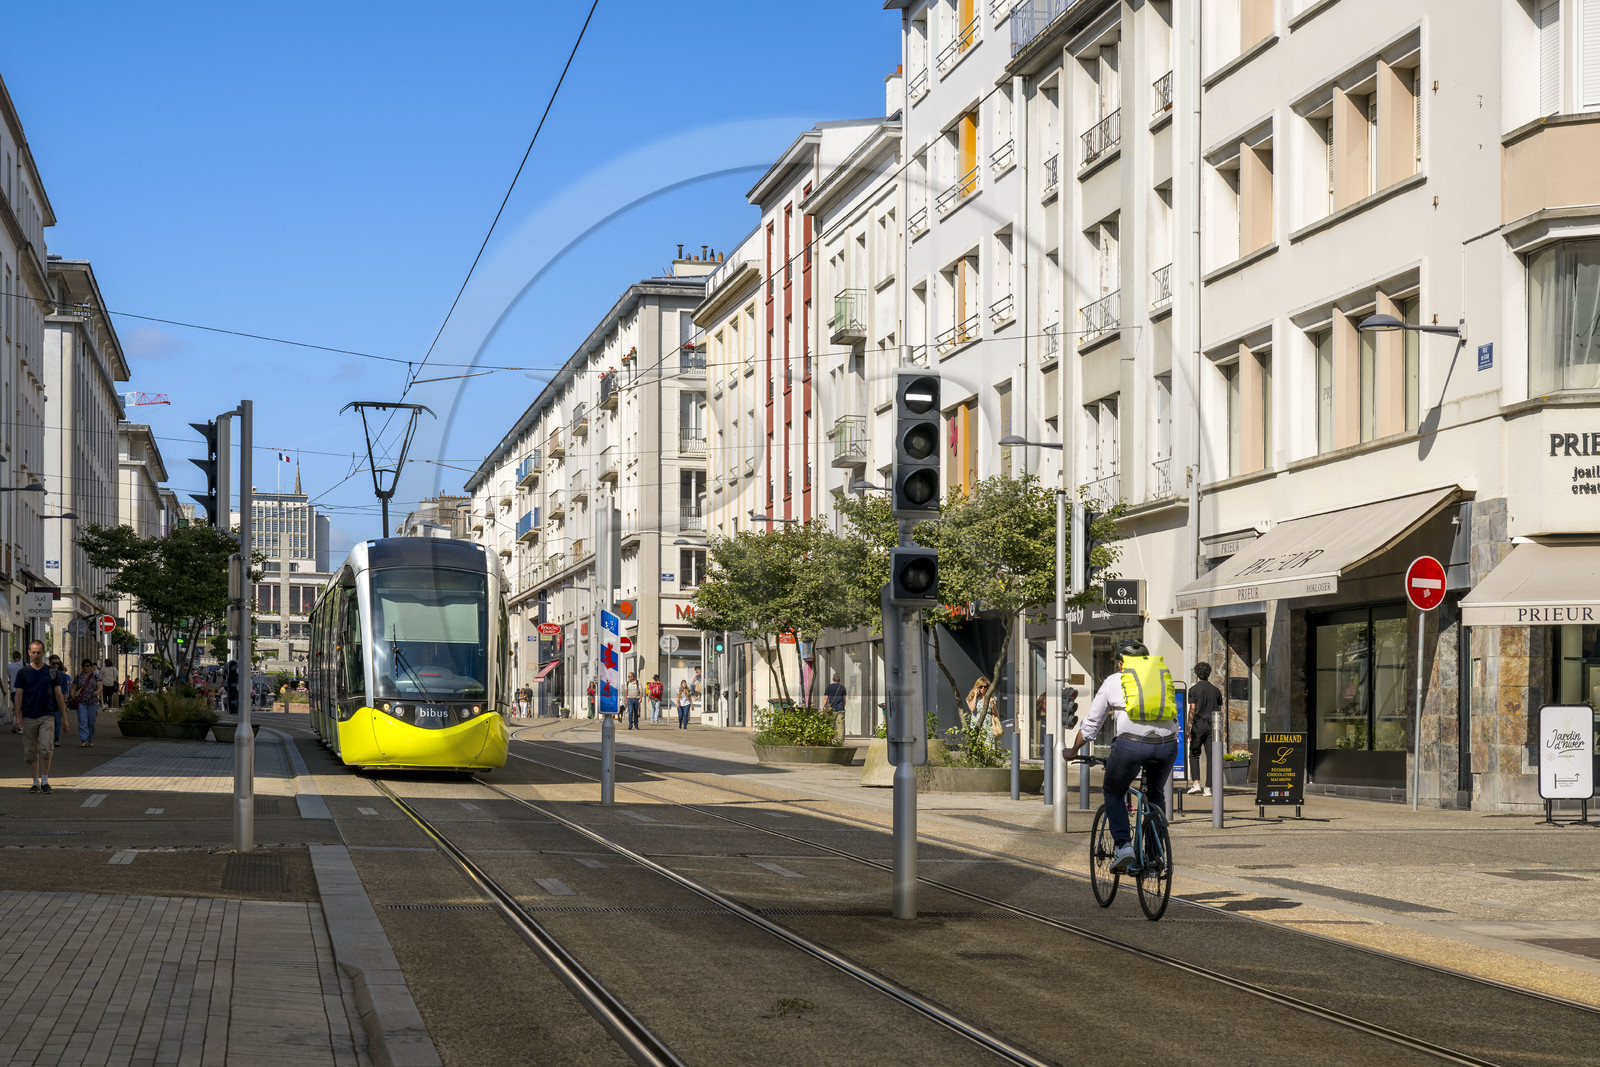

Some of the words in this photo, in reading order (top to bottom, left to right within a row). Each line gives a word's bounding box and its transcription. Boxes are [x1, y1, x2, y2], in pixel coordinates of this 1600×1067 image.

[1221, 541, 1240, 554] PRIEUR
[1234, 549, 1325, 577] PRIEUR
[1237, 587, 1259, 601] PRIEUR
[1107, 596, 1137, 606] Acuitis
[28, 607, 52, 615] express
[1517, 607, 1593, 622] PRIEUR
[420, 707, 448, 718] bibus
[1265, 735, 1302, 743] LALLEMAND
[1546, 728, 1581, 749] Jardin
[1554, 739, 1585, 750] d'hiver
